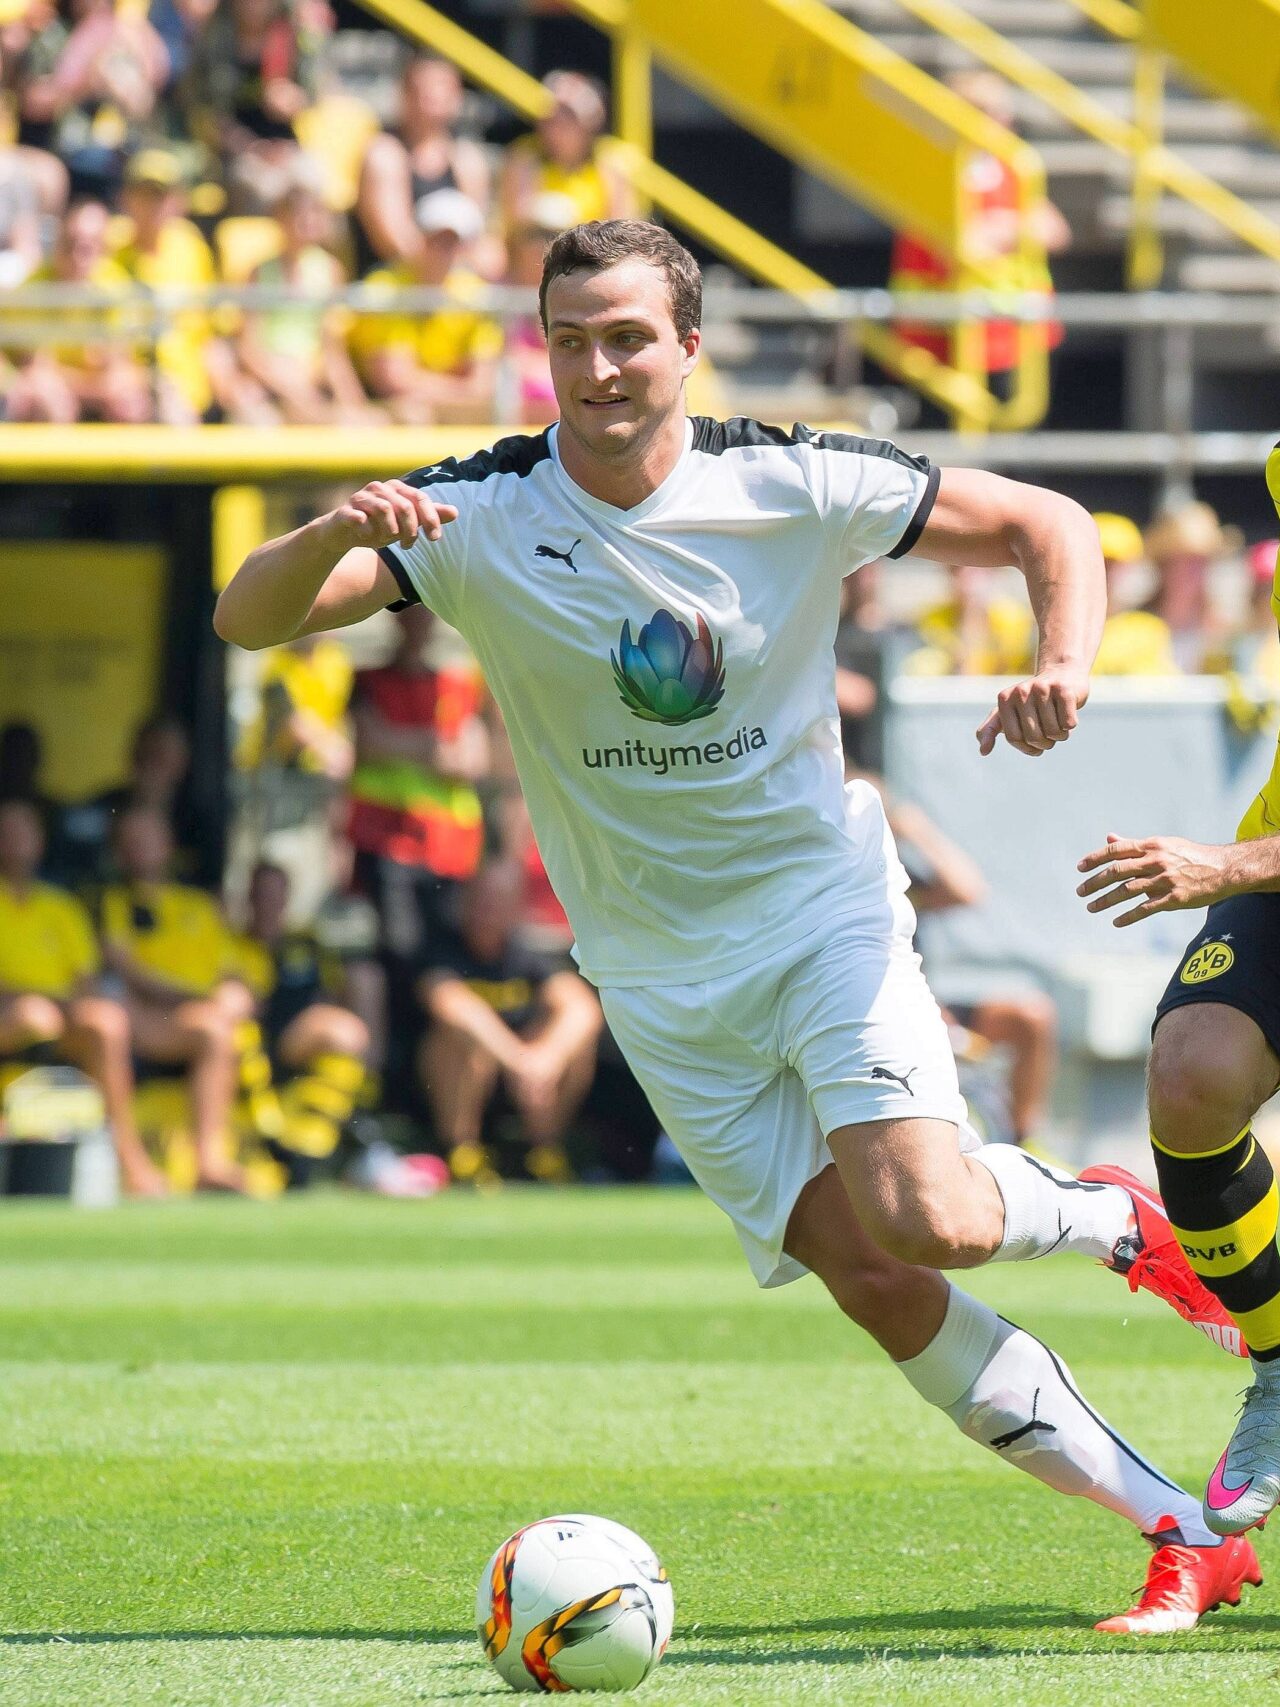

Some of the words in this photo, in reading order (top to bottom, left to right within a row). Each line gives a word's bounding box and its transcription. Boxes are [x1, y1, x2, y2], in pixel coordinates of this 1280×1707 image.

[581, 726, 769, 776] unitymedia
[1186, 946, 1227, 975] BVB
[1193, 968, 1208, 979] 09
[1181, 1242, 1236, 1261] BVB
[1193, 1321, 1241, 1357] MA
